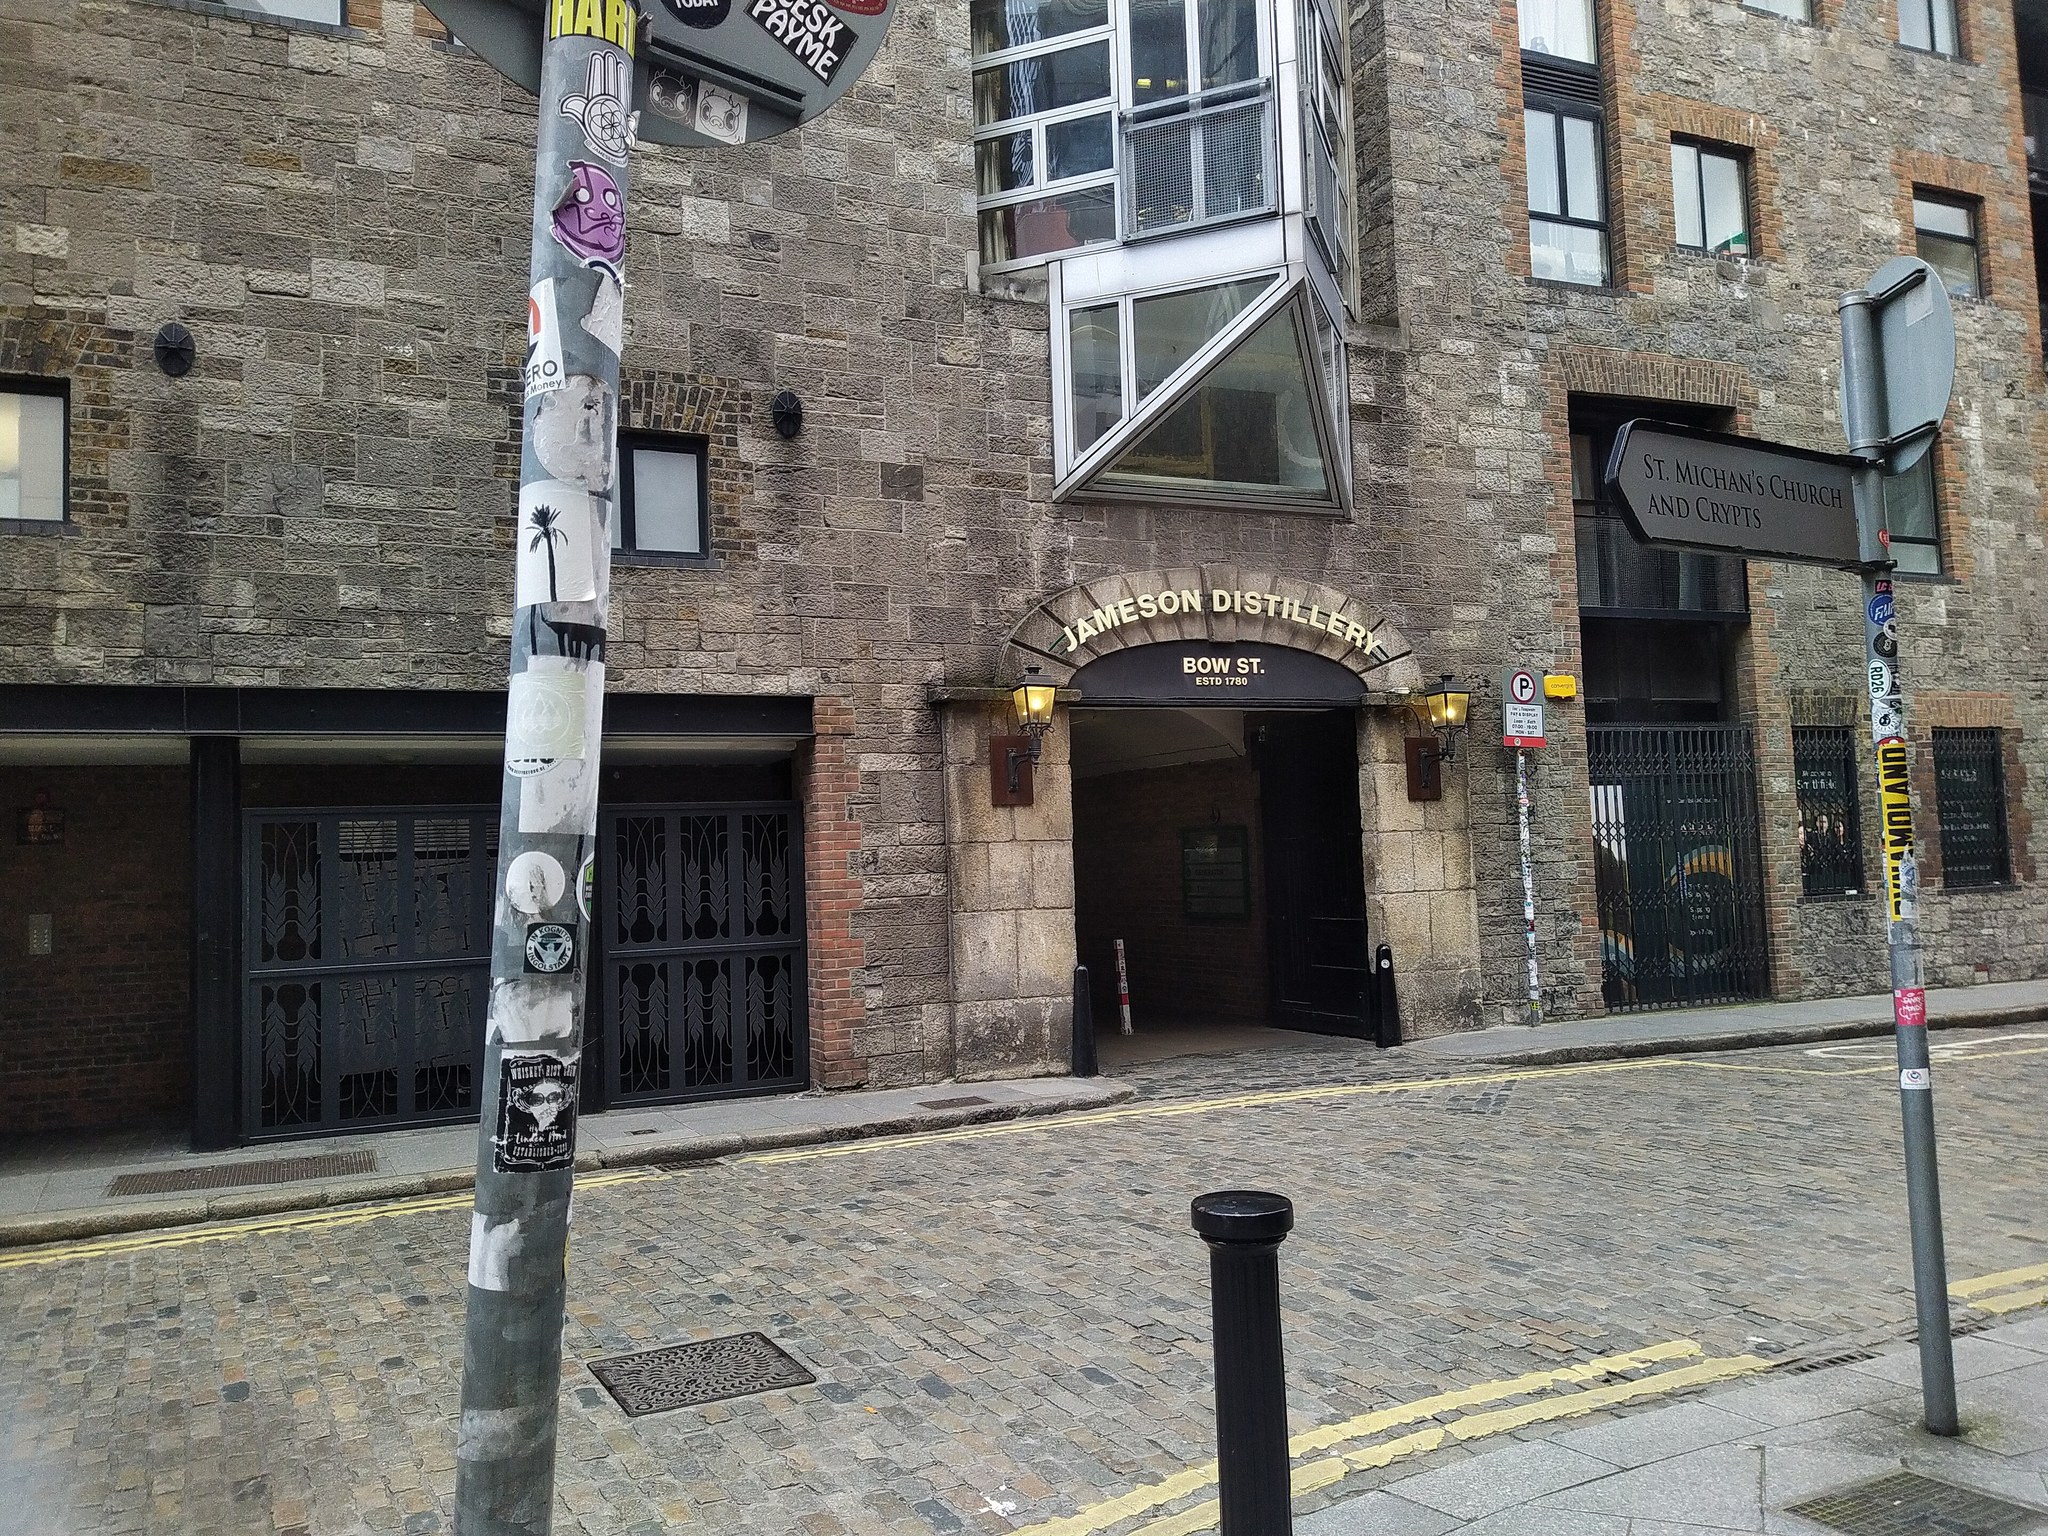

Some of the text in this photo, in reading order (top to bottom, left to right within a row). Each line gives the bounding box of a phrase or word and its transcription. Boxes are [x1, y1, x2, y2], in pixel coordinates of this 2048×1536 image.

[752, 0, 839, 80] PAYME
[530, 380, 562, 394] Money
[1643, 453, 1843, 509] ST. MICHAN'S CHURCH
[1647, 493, 1762, 529] AND CRYPTS
[1062, 589, 1383, 656] JAMESON DISTILLERY
[1183, 657, 1265, 675] BOW ST.
[1870, 666, 1885, 694] RD26
[1195, 677, 1248, 686] ESTD 1780
[1882, 747, 1914, 915] AMOLAND
[538, 926, 570, 942] KOGNITO
[527, 951, 570, 970] INGOLSTADT
